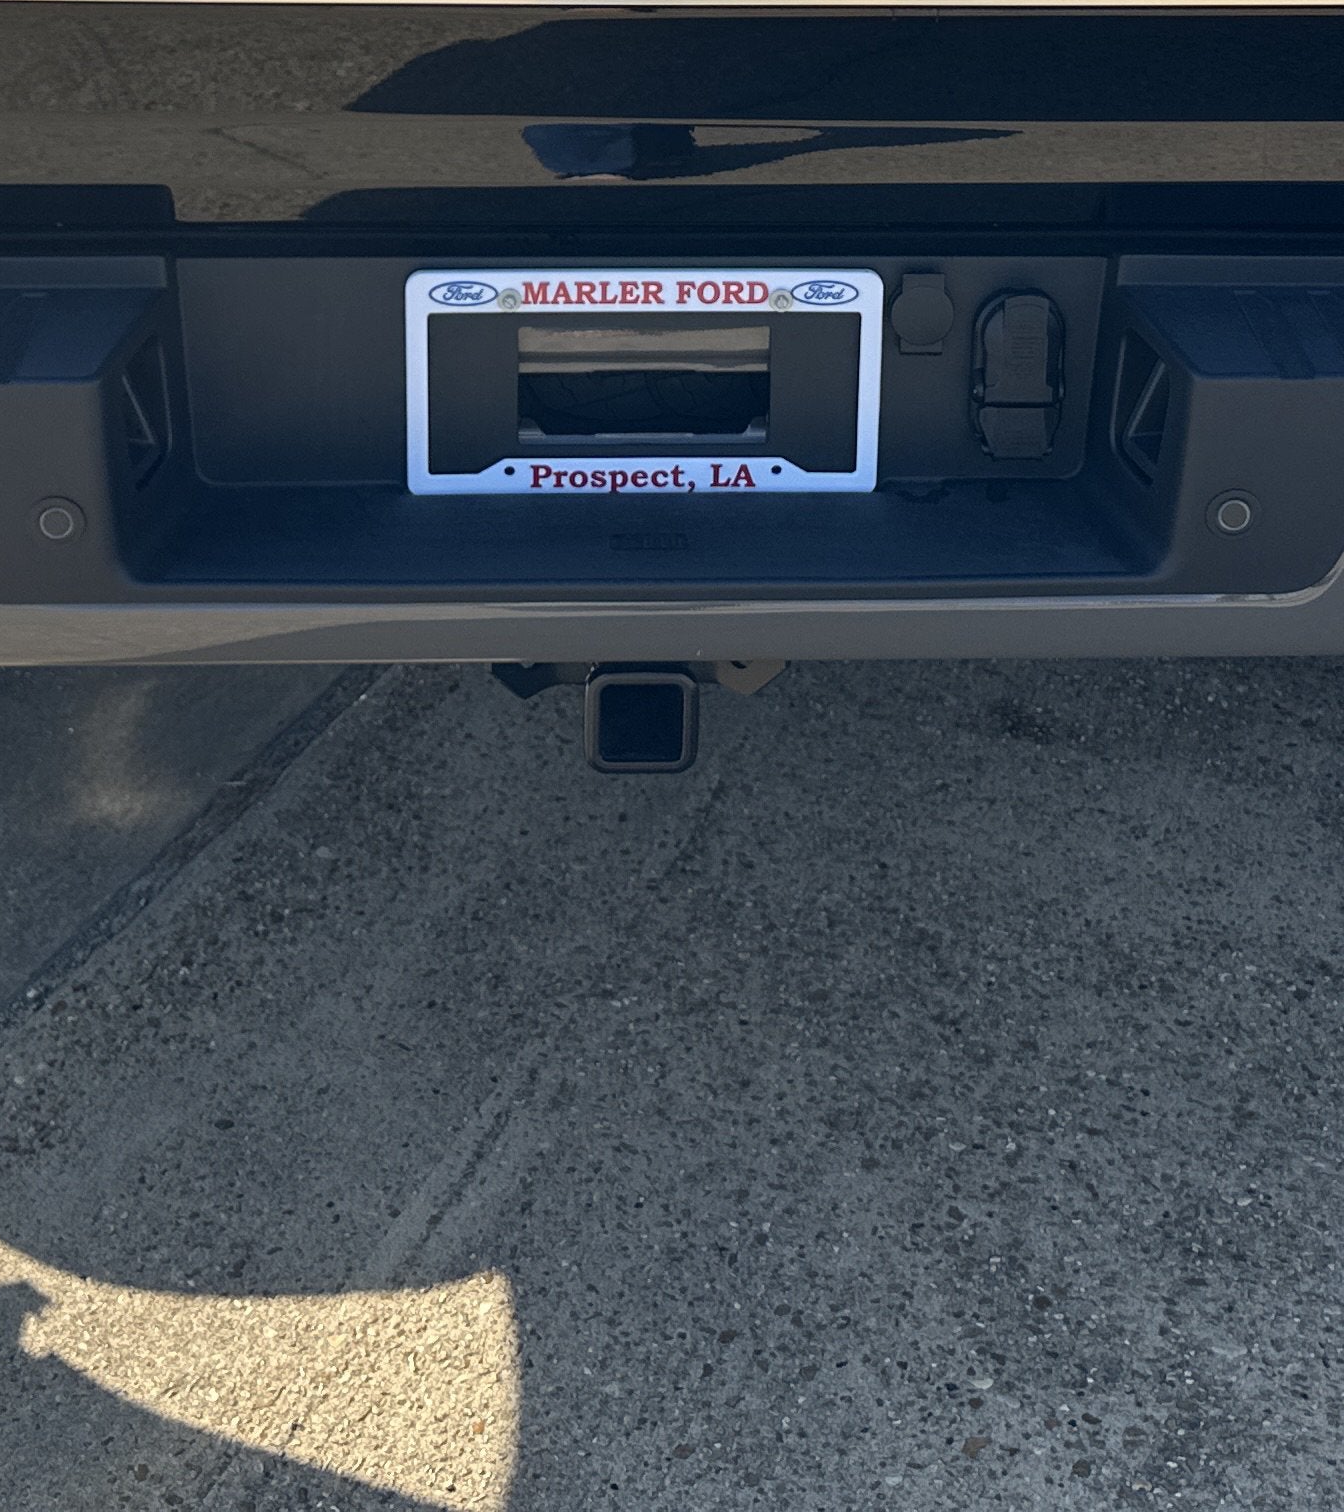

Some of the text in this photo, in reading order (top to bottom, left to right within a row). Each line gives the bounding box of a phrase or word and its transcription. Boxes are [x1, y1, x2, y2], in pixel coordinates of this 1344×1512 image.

[442, 281, 845, 305] Ford MARLER FORD Ford
[530, 464, 756, 493] Prospect, LA
